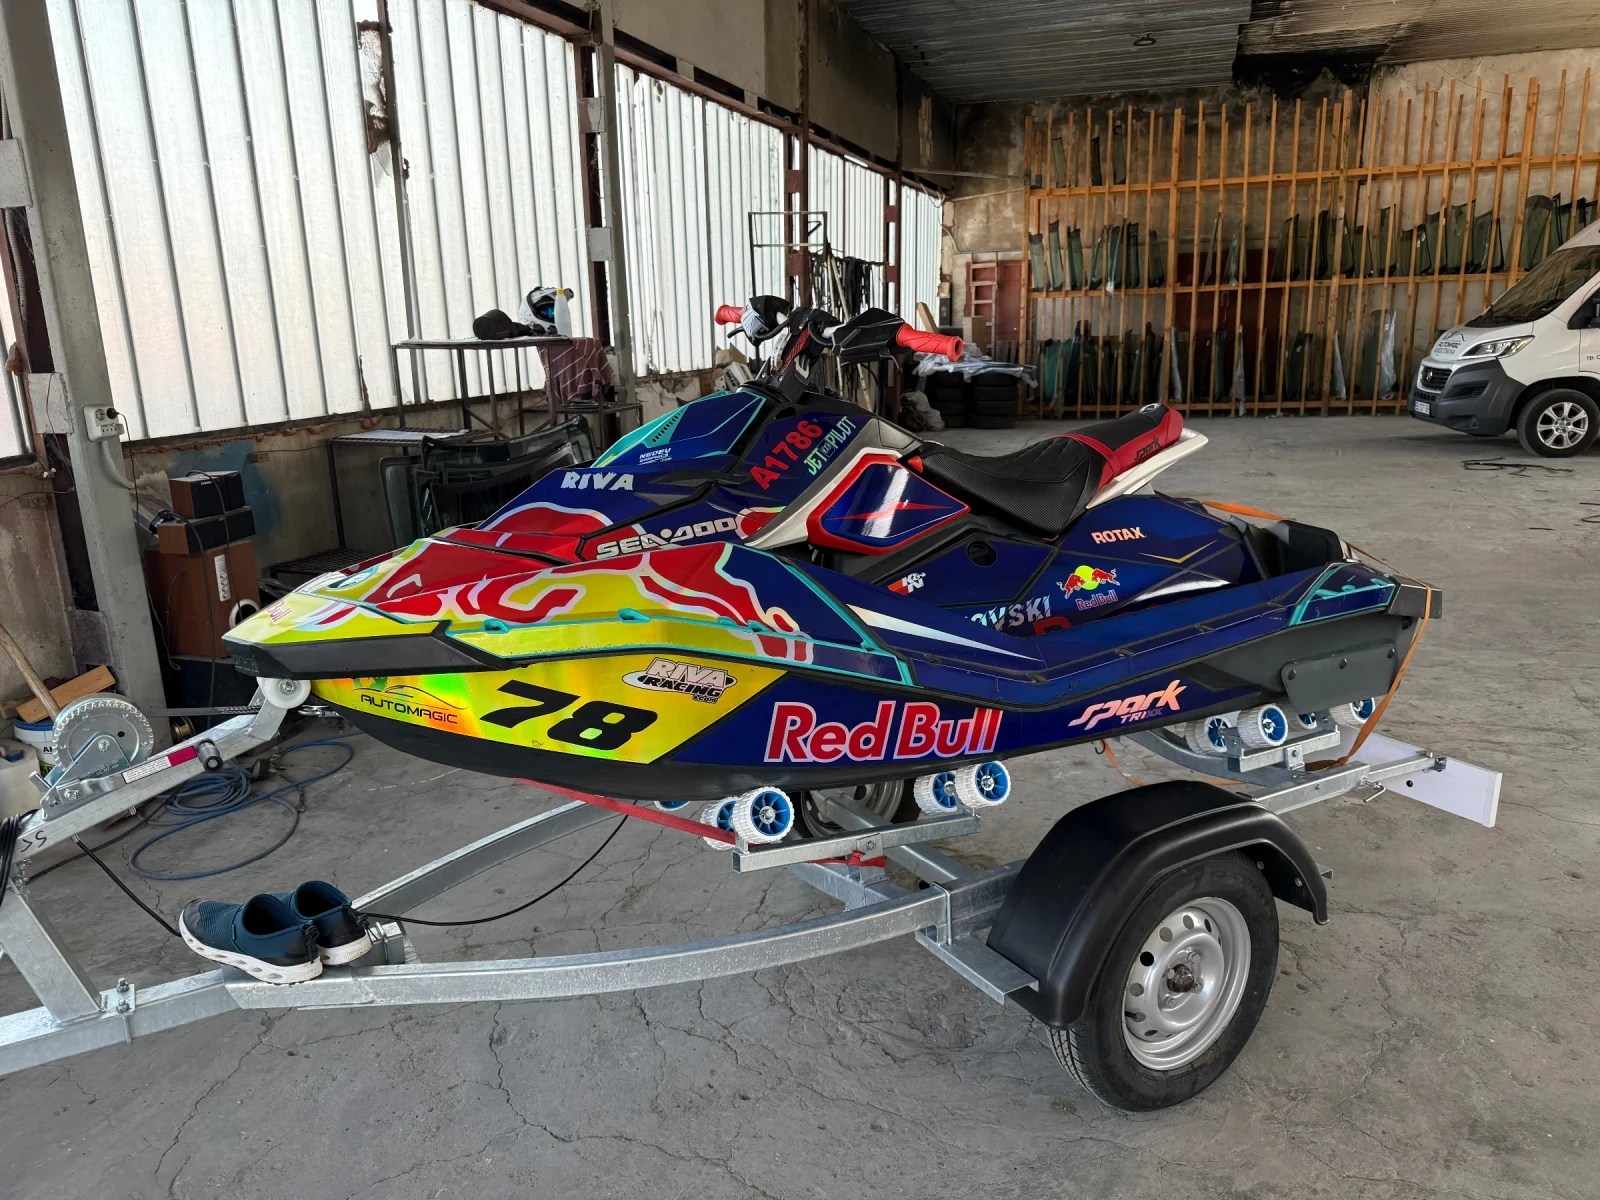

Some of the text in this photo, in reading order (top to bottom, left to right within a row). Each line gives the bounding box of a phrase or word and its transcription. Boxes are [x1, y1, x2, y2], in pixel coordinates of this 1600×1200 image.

[750, 420, 823, 490] A1786
[803, 447, 828, 476] JET
[560, 471, 634, 491] RIVA
[1091, 527, 1145, 544] ROTAX
[1075, 589, 1118, 611] Red Bull
[646, 657, 728, 688] RIVA
[642, 677, 721, 698] RACING
[361, 694, 458, 725] AUTOMAGIC
[479, 679, 659, 751] 78
[1120, 708, 1164, 724] TRIXX
[763, 700, 1003, 763] Red Bull
